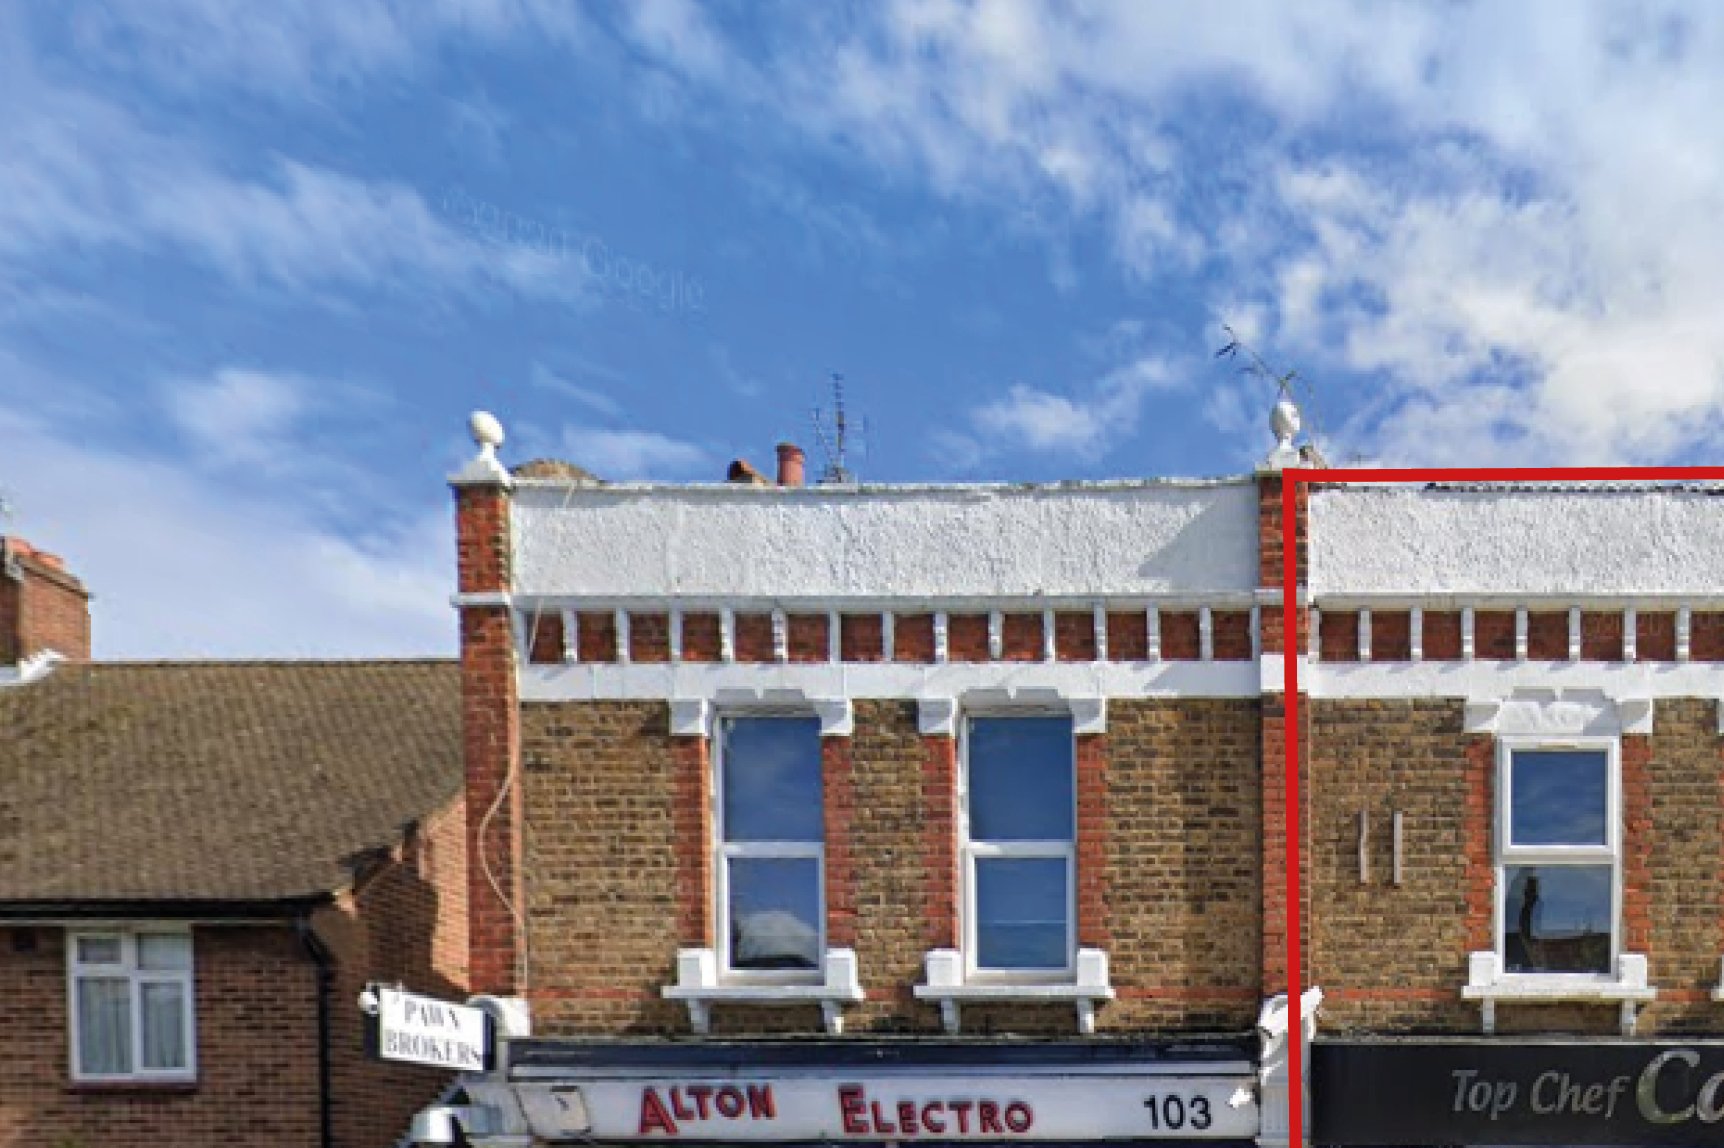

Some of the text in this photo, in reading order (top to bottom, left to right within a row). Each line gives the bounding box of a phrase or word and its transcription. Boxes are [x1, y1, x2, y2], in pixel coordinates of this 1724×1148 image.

[383, 1029, 482, 1066] BROKERS
[1143, 1093, 1214, 1131] 103
[1450, 1069, 1519, 1121] Top
[1529, 1069, 1632, 1120] Chef
